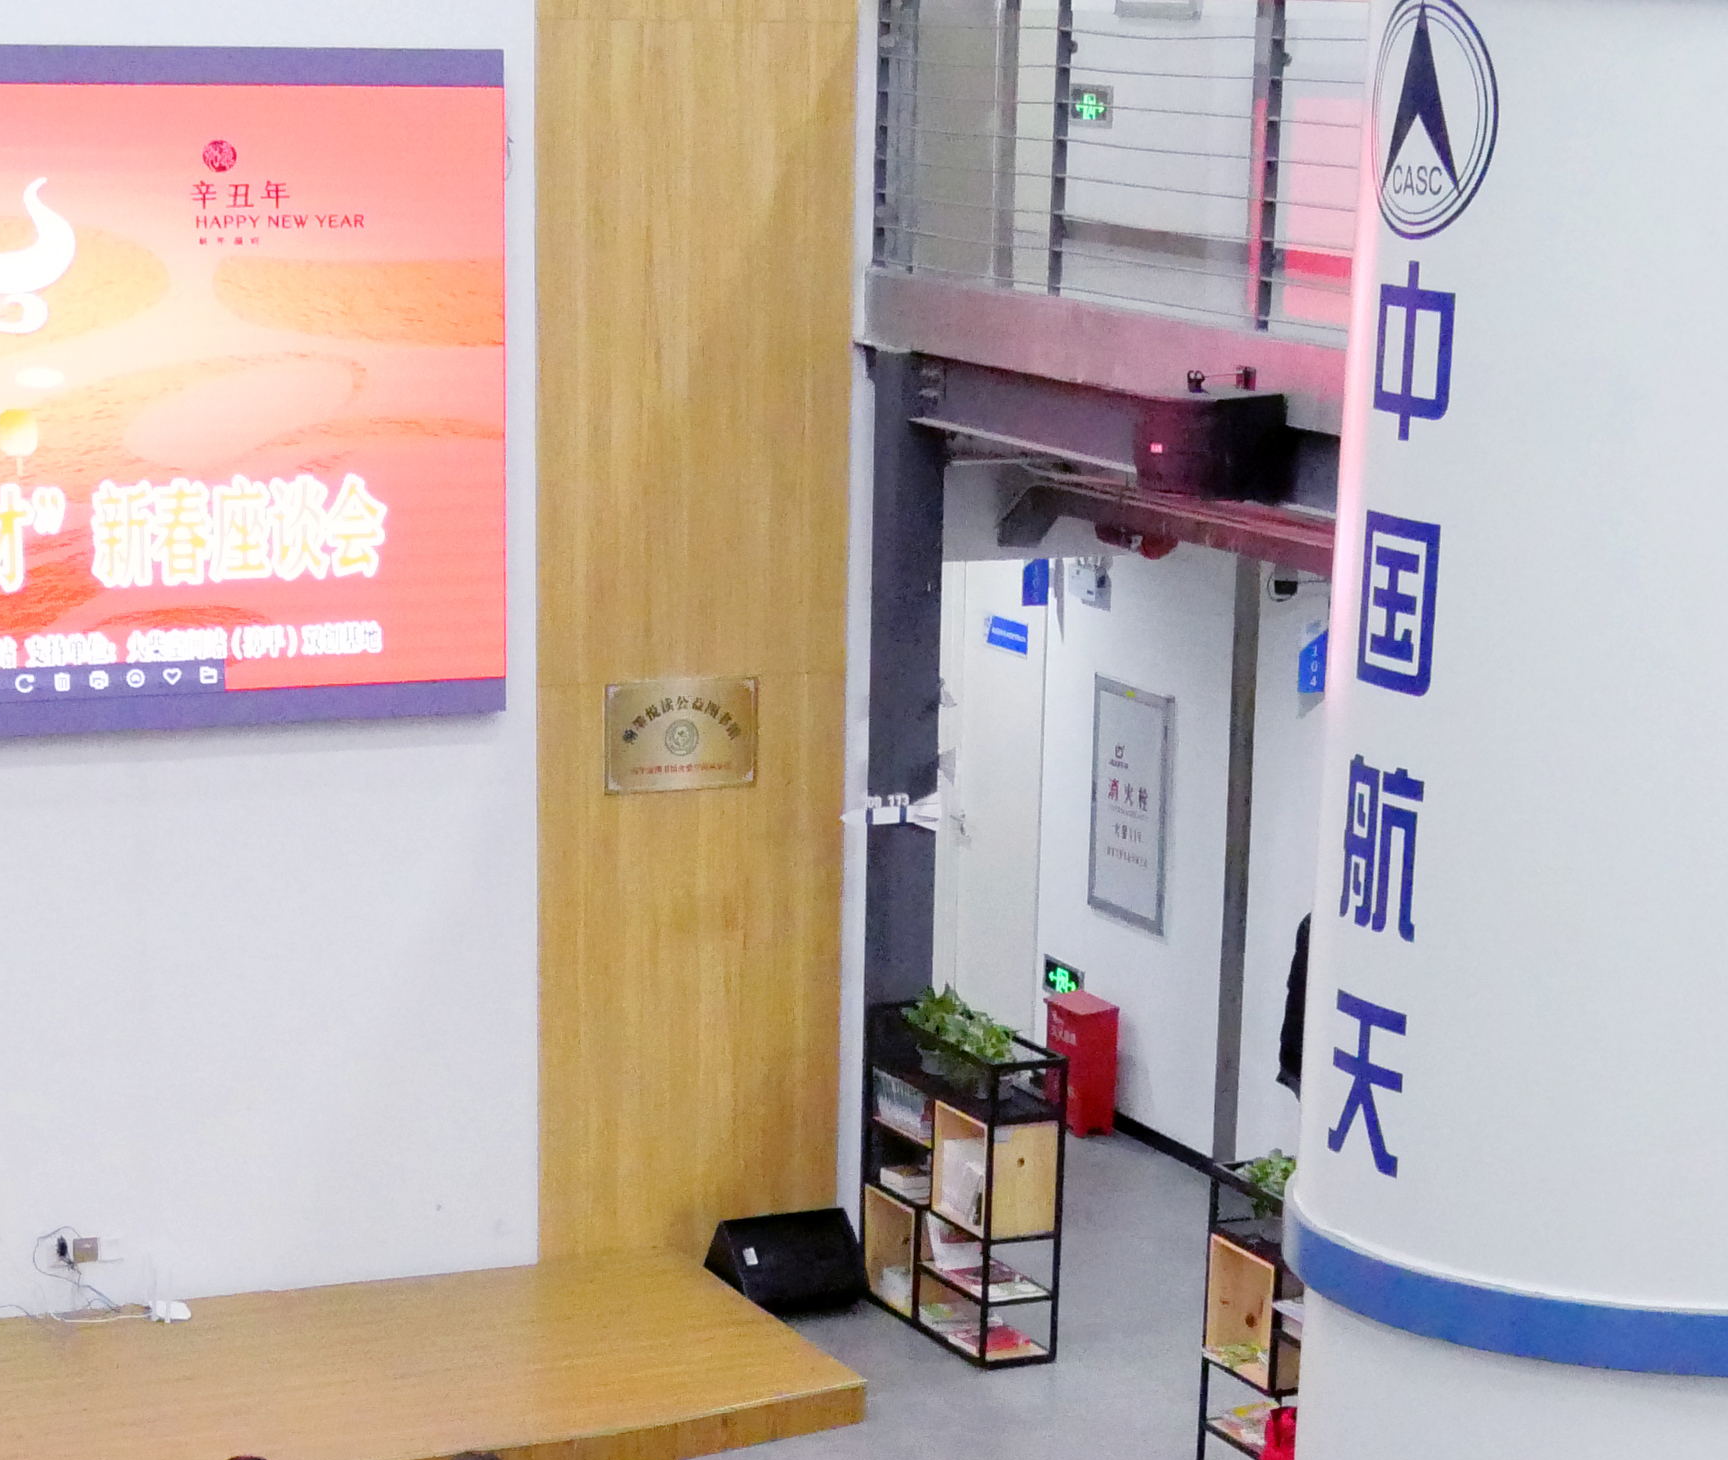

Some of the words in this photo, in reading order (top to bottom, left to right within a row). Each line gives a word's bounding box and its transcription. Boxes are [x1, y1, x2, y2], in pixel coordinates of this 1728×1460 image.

[190, 180, 290, 210] 辛丑年
[1392, 164, 1443, 196] CASC
[195, 214, 260, 229] HAPPY
[267, 214, 309, 229] NEW
[315, 213, 365, 228] YEAR
[90, 472, 389, 590] 新春座谈会
[1309, 643, 1319, 687] 104
[1327, 261, 1456, 1178] 中国航天
[1106, 777, 1149, 812] 消火栓
